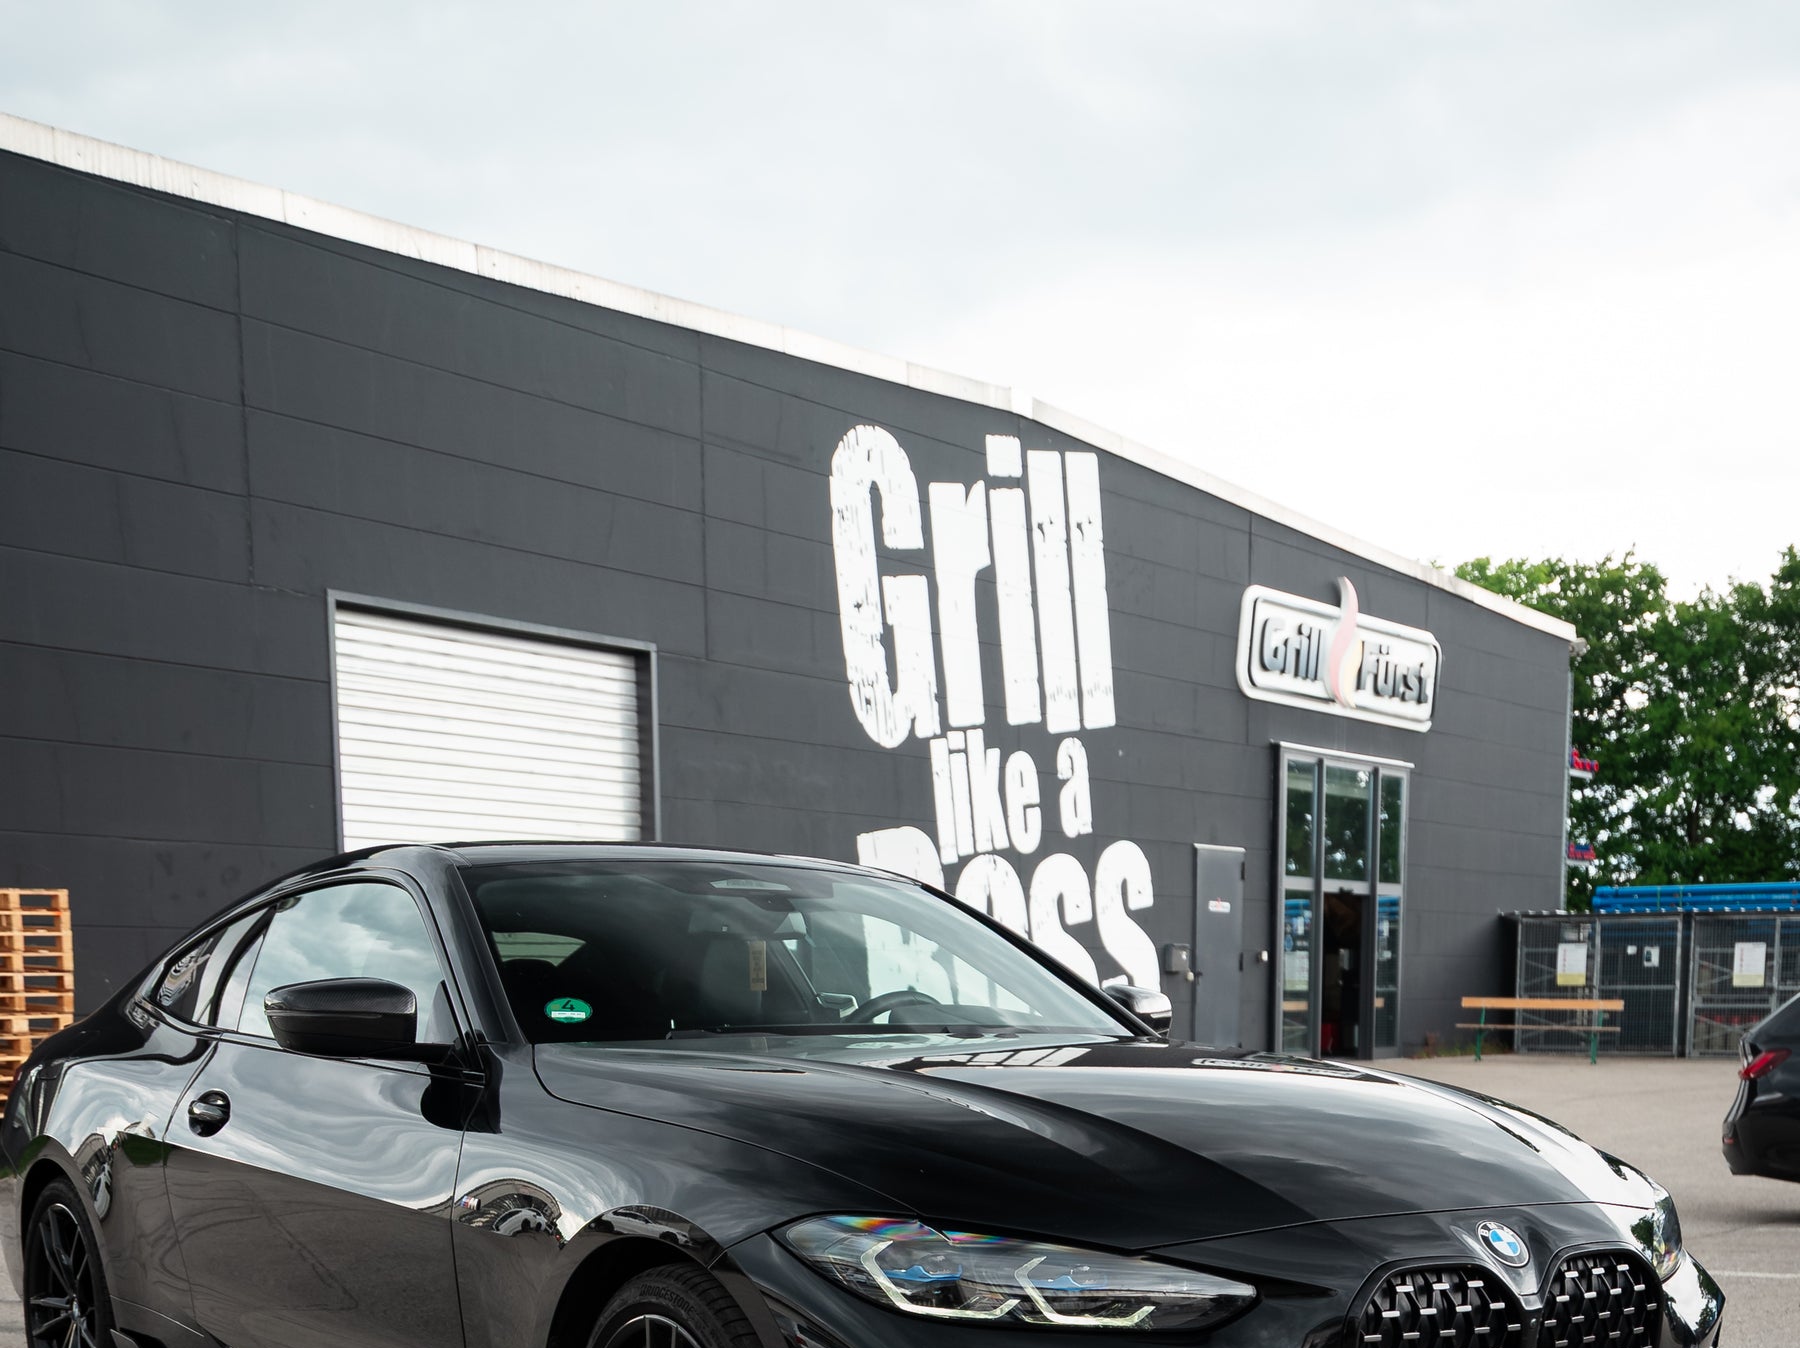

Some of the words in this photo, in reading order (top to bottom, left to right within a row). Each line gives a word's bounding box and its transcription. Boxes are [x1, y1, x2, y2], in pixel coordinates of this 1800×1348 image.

[829, 424, 1117, 748] Grill
[1261, 617, 1326, 682] Grill
[1356, 639, 1429, 705] Fürst
[930, 728, 1042, 865] like
[1056, 736, 1093, 838] a
[561, 999, 576, 1012] 4
